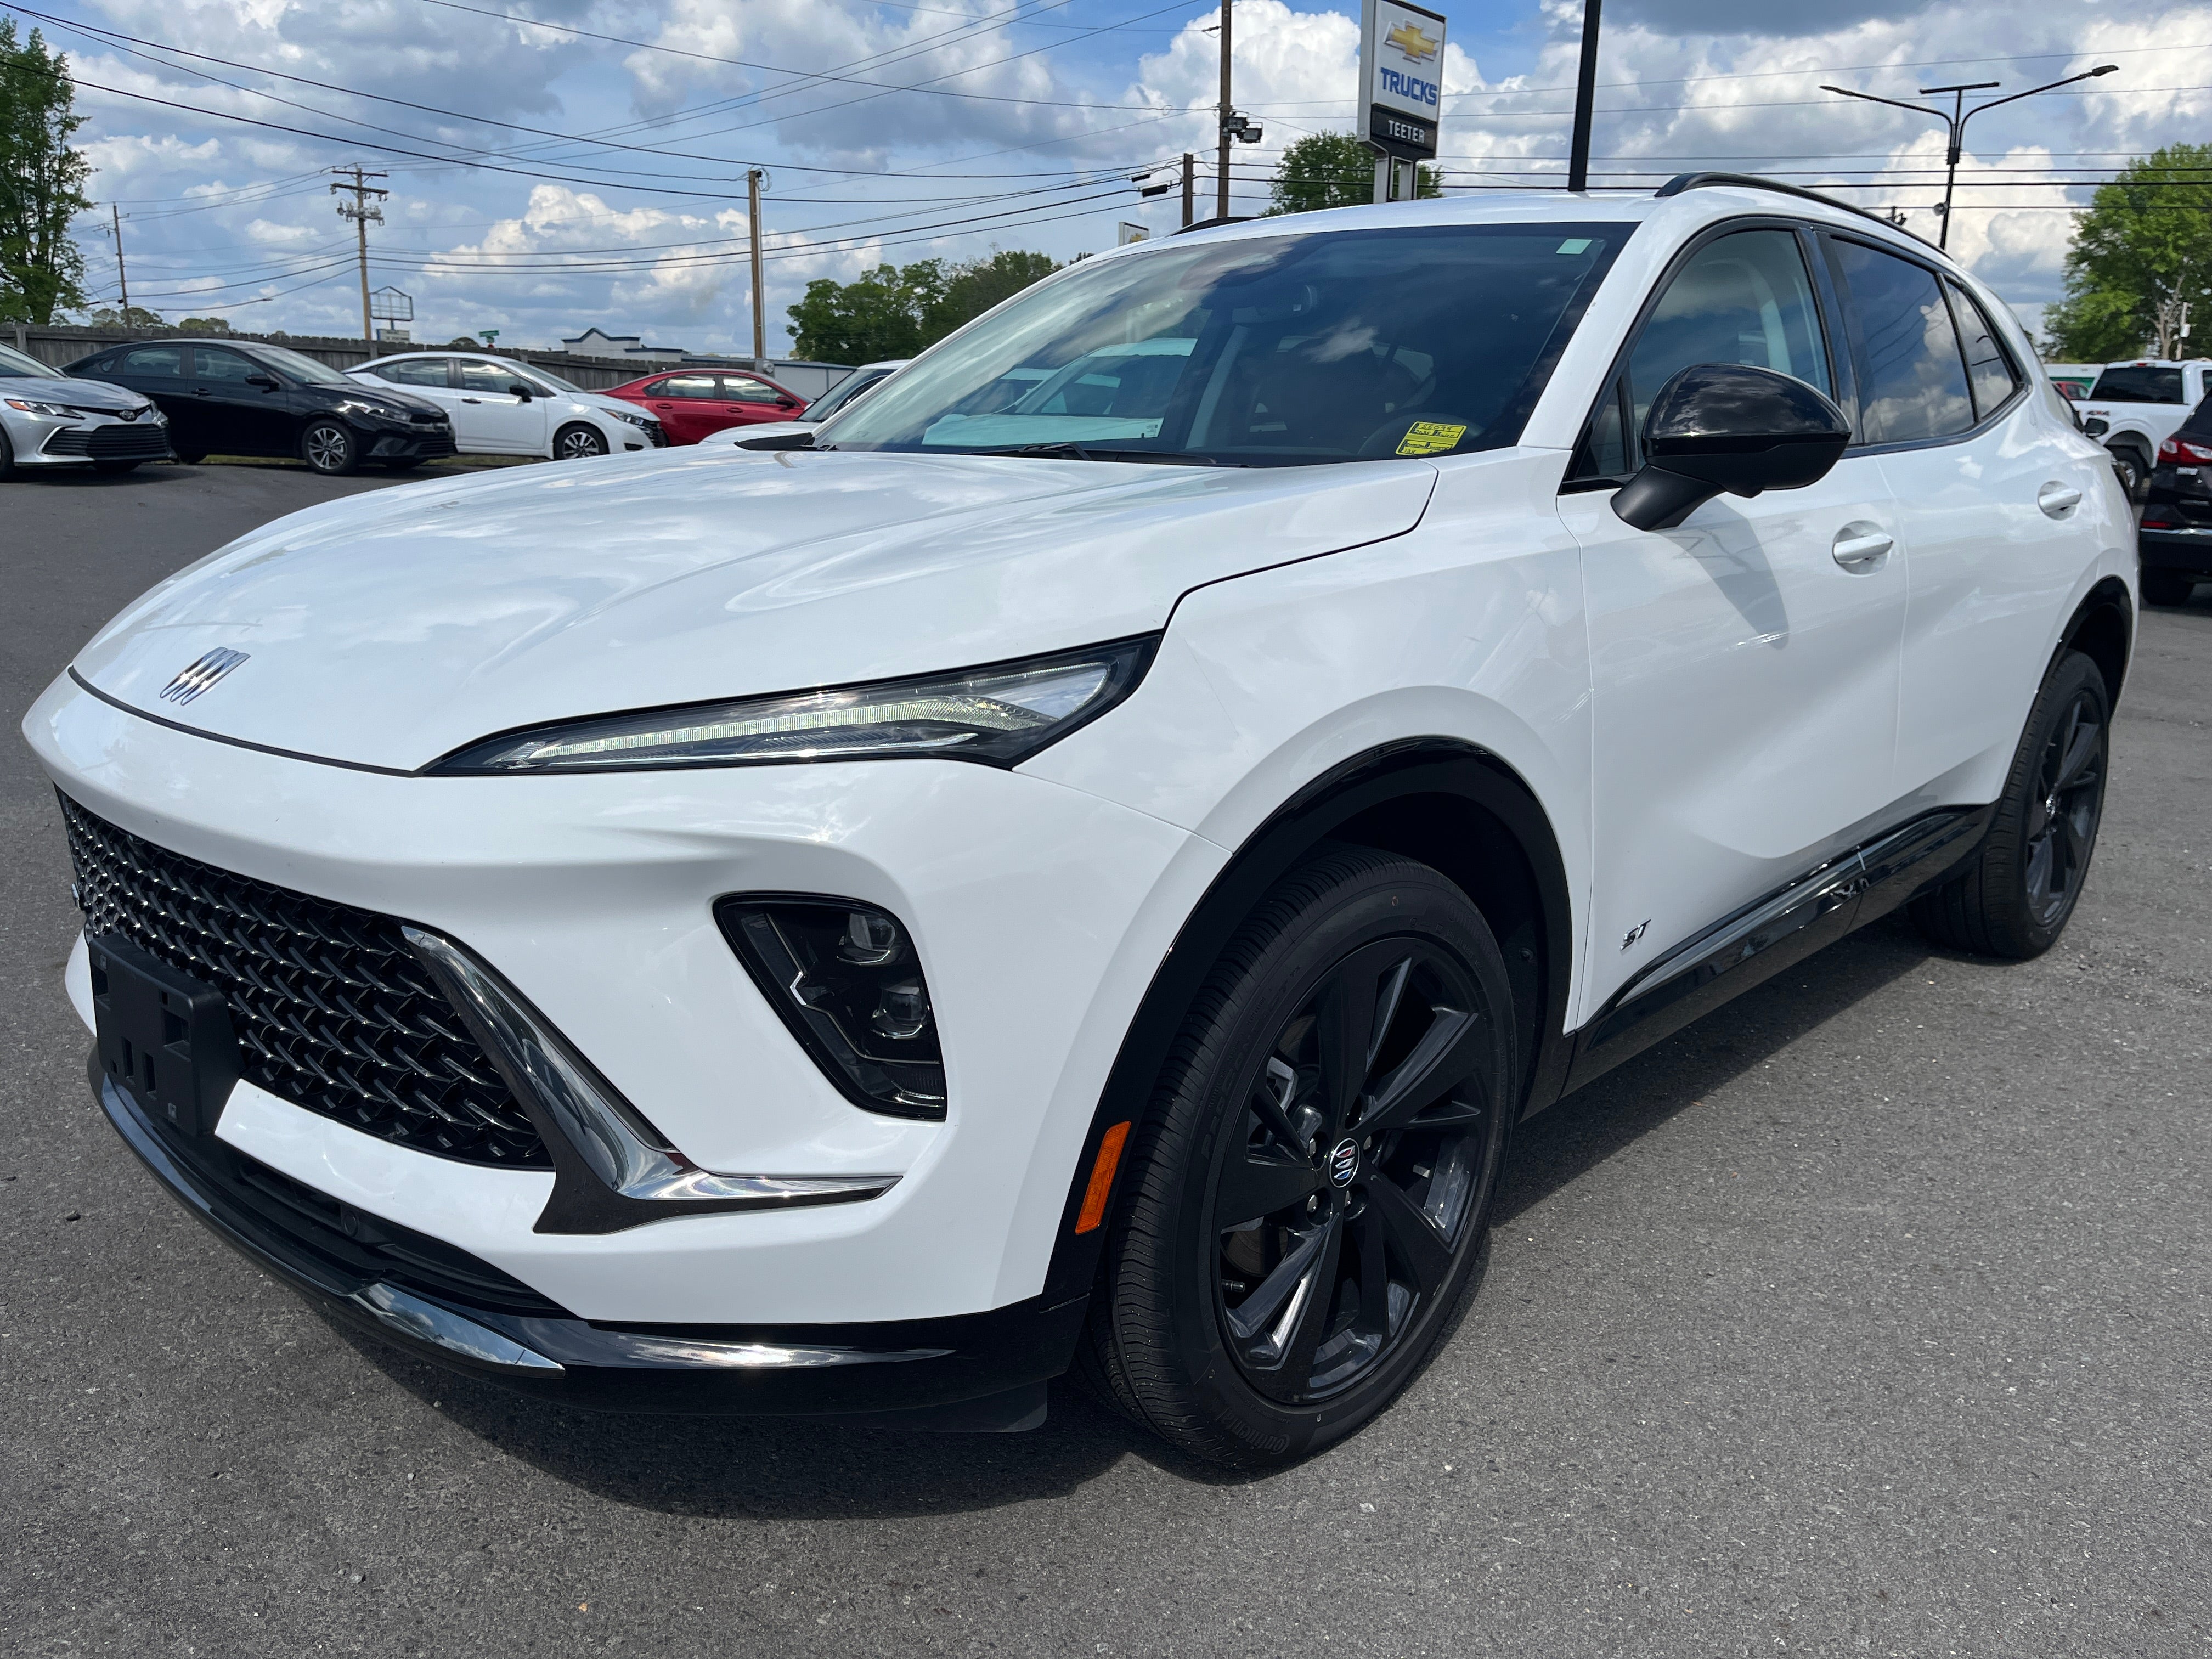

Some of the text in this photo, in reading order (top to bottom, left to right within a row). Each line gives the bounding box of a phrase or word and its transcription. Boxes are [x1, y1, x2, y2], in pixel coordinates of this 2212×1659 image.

[1380, 67, 1437, 105] TRUCKS
[1388, 120, 1425, 144] TEETER
[1620, 919, 1651, 950] ST
